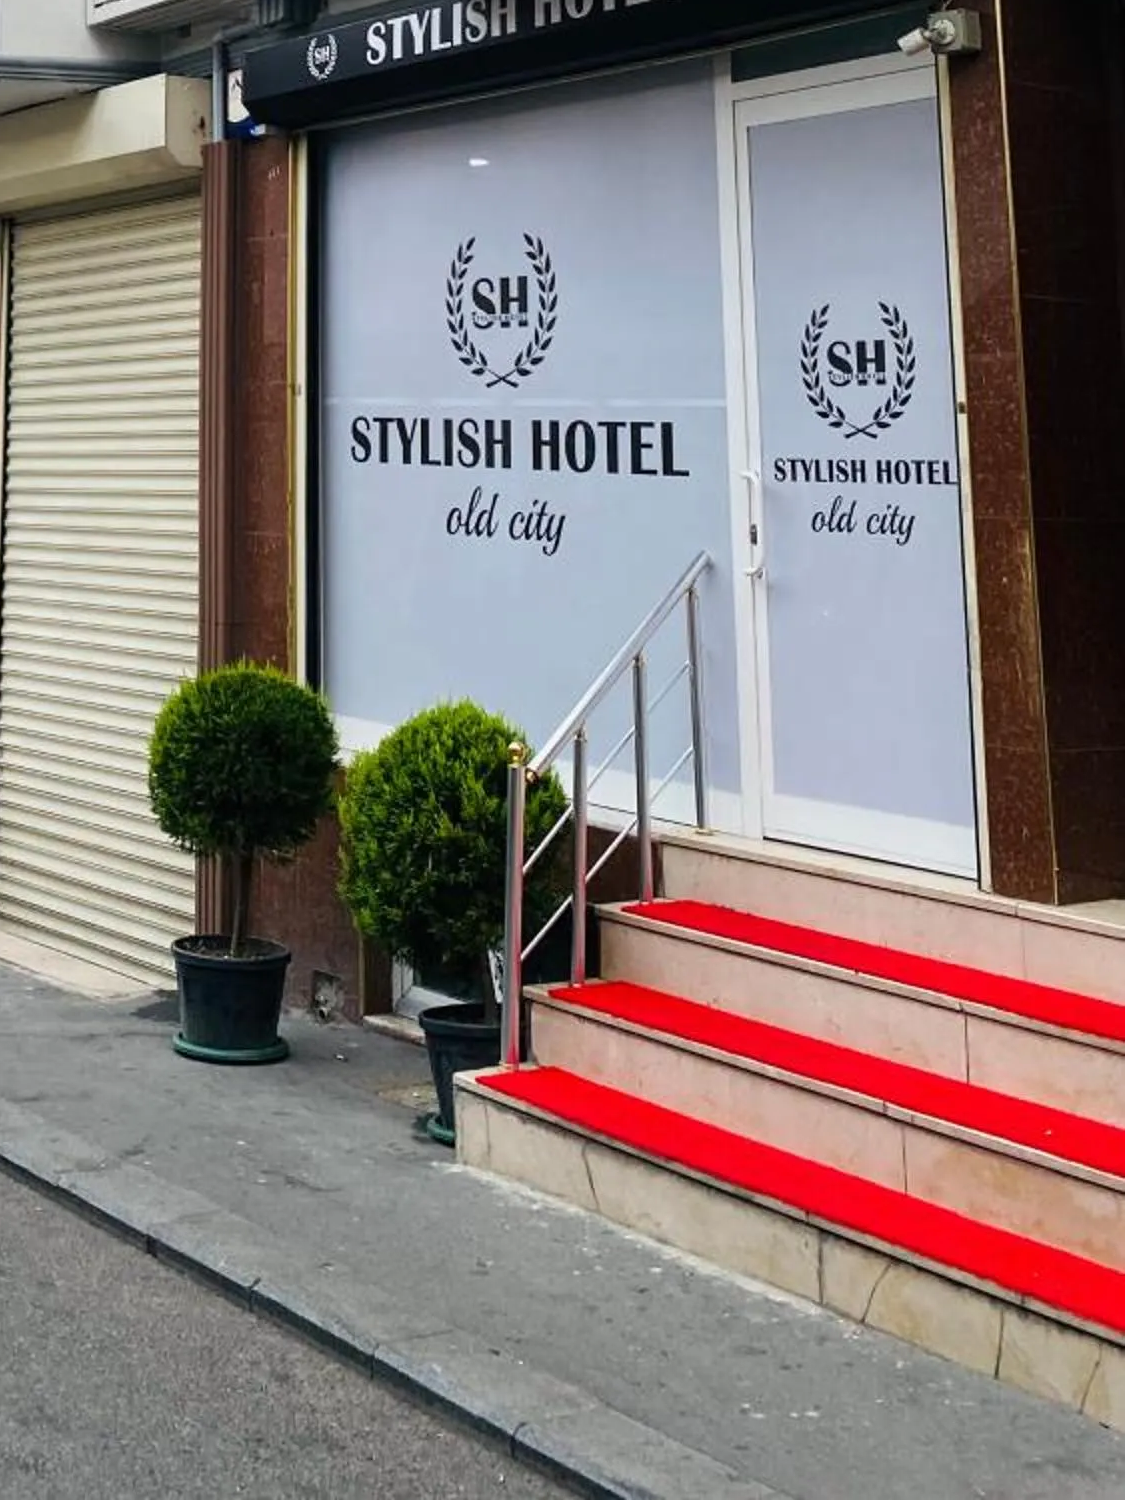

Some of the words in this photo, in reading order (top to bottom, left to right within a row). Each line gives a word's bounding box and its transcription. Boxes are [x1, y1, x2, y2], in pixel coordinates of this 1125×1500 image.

[472, 276, 528, 329] SH
[827, 340, 886, 387] SH
[351, 416, 512, 469] STYLISH
[532, 419, 690, 477] HOTEL
[774, 457, 867, 483] STYLISH
[876, 460, 958, 485] HOTEL
[446, 485, 499, 538] old
[508, 499, 566, 557] city
[811, 495, 858, 534] old
[866, 504, 916, 546] city
